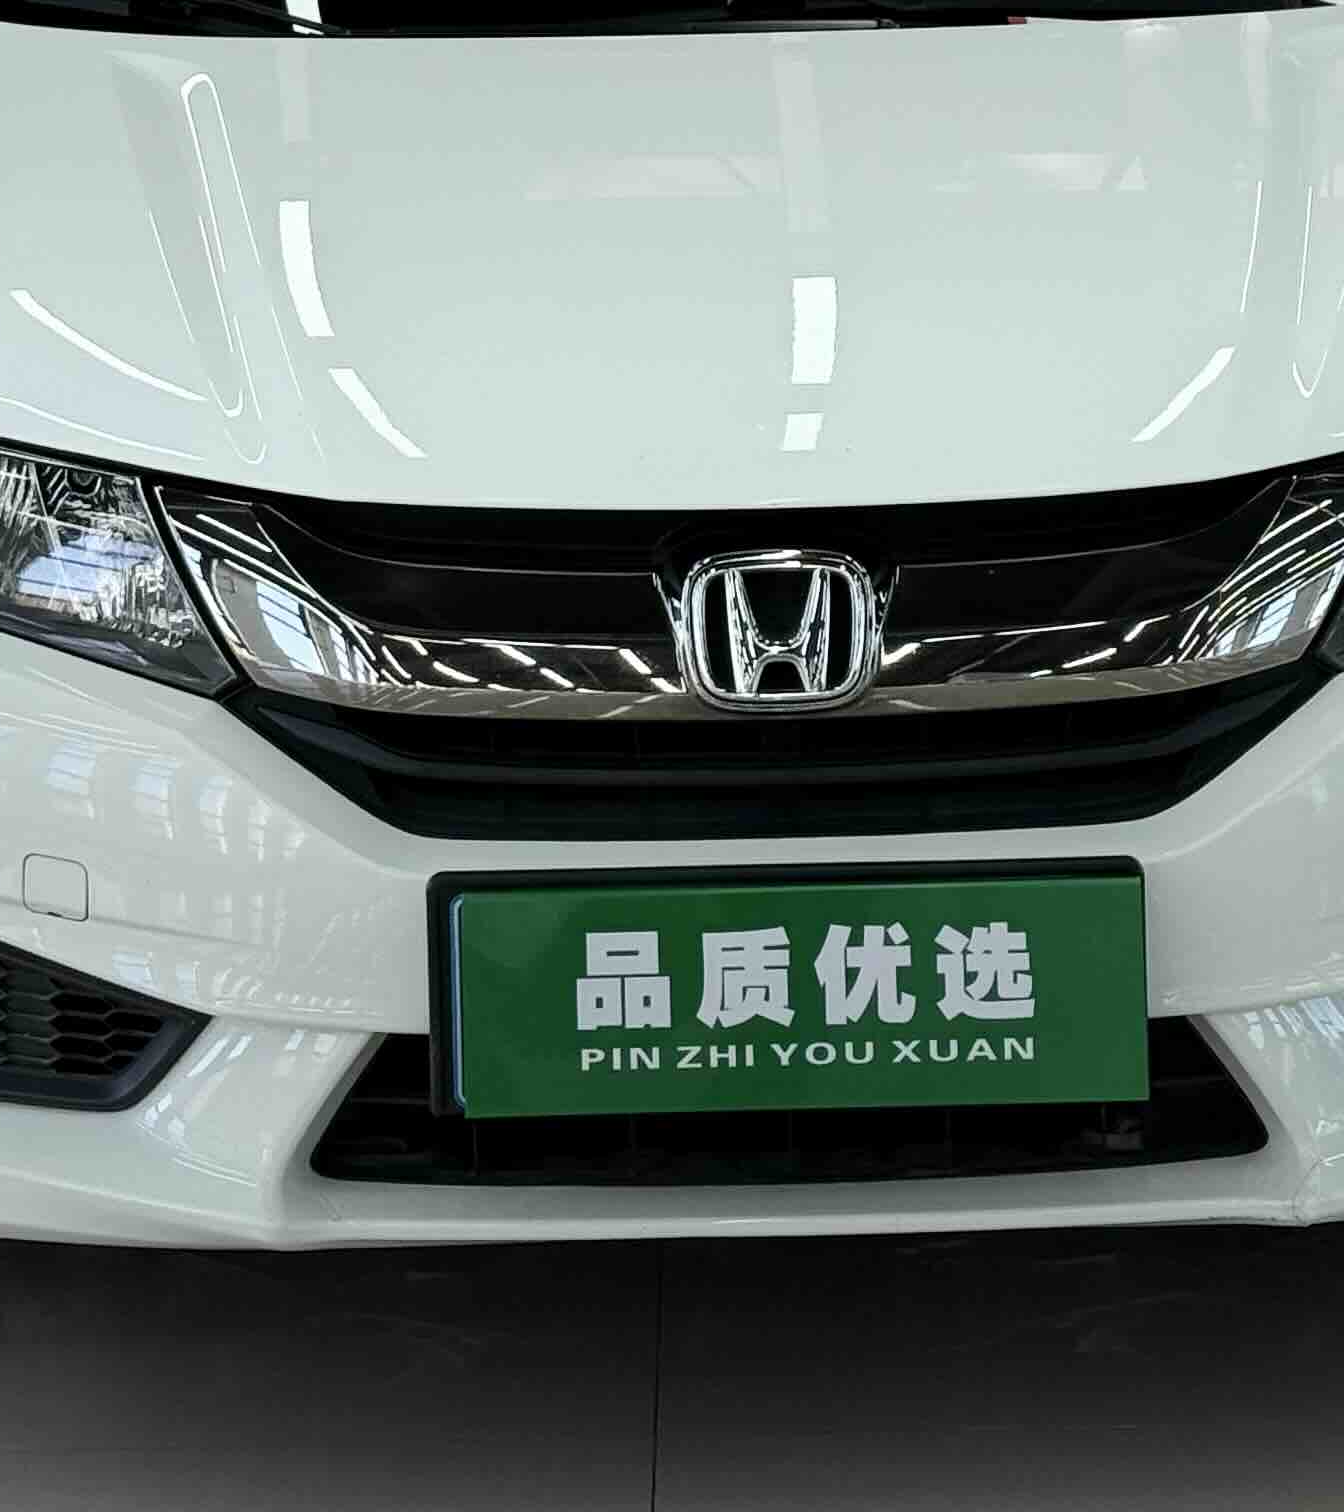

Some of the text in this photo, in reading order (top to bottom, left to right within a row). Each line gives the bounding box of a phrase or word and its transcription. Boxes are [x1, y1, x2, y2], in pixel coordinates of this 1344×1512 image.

[576, 922, 1036, 1031] 品质优选
[581, 1036, 1036, 1071] PIN ZHI YOU XUAN
